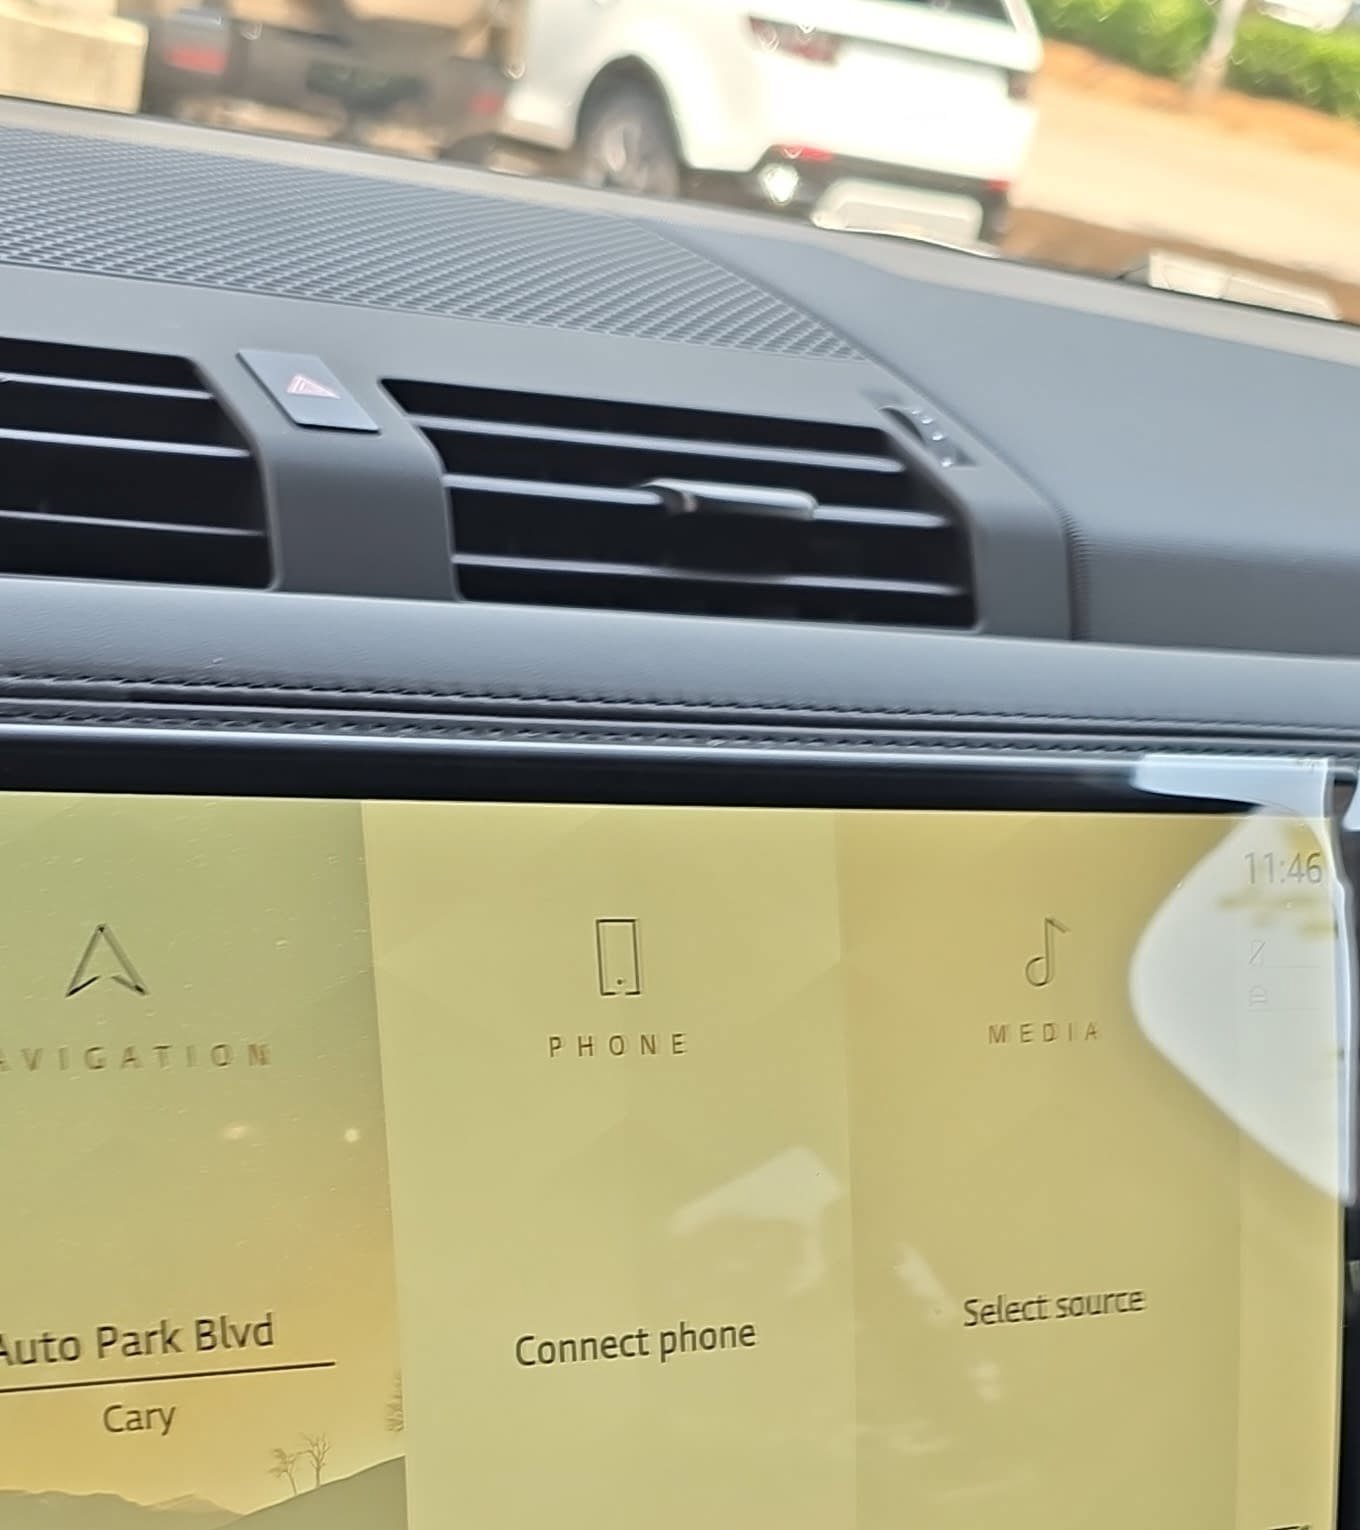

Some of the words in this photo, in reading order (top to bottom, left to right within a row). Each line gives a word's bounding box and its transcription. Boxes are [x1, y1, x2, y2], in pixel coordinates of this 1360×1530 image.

[1244, 851, 1323, 885] 11:46
[548, 1032, 688, 1058] PHONE
[988, 1021, 1098, 1045] MEDIA
[963, 1295, 1050, 1327] Select
[1055, 1291, 1148, 1319] source
[96, 1319, 183, 1358] Park
[196, 1313, 275, 1351] Blvd
[516, 1328, 650, 1367] Connect
[659, 1320, 756, 1363] phone
[103, 1404, 177, 1436] Cary
